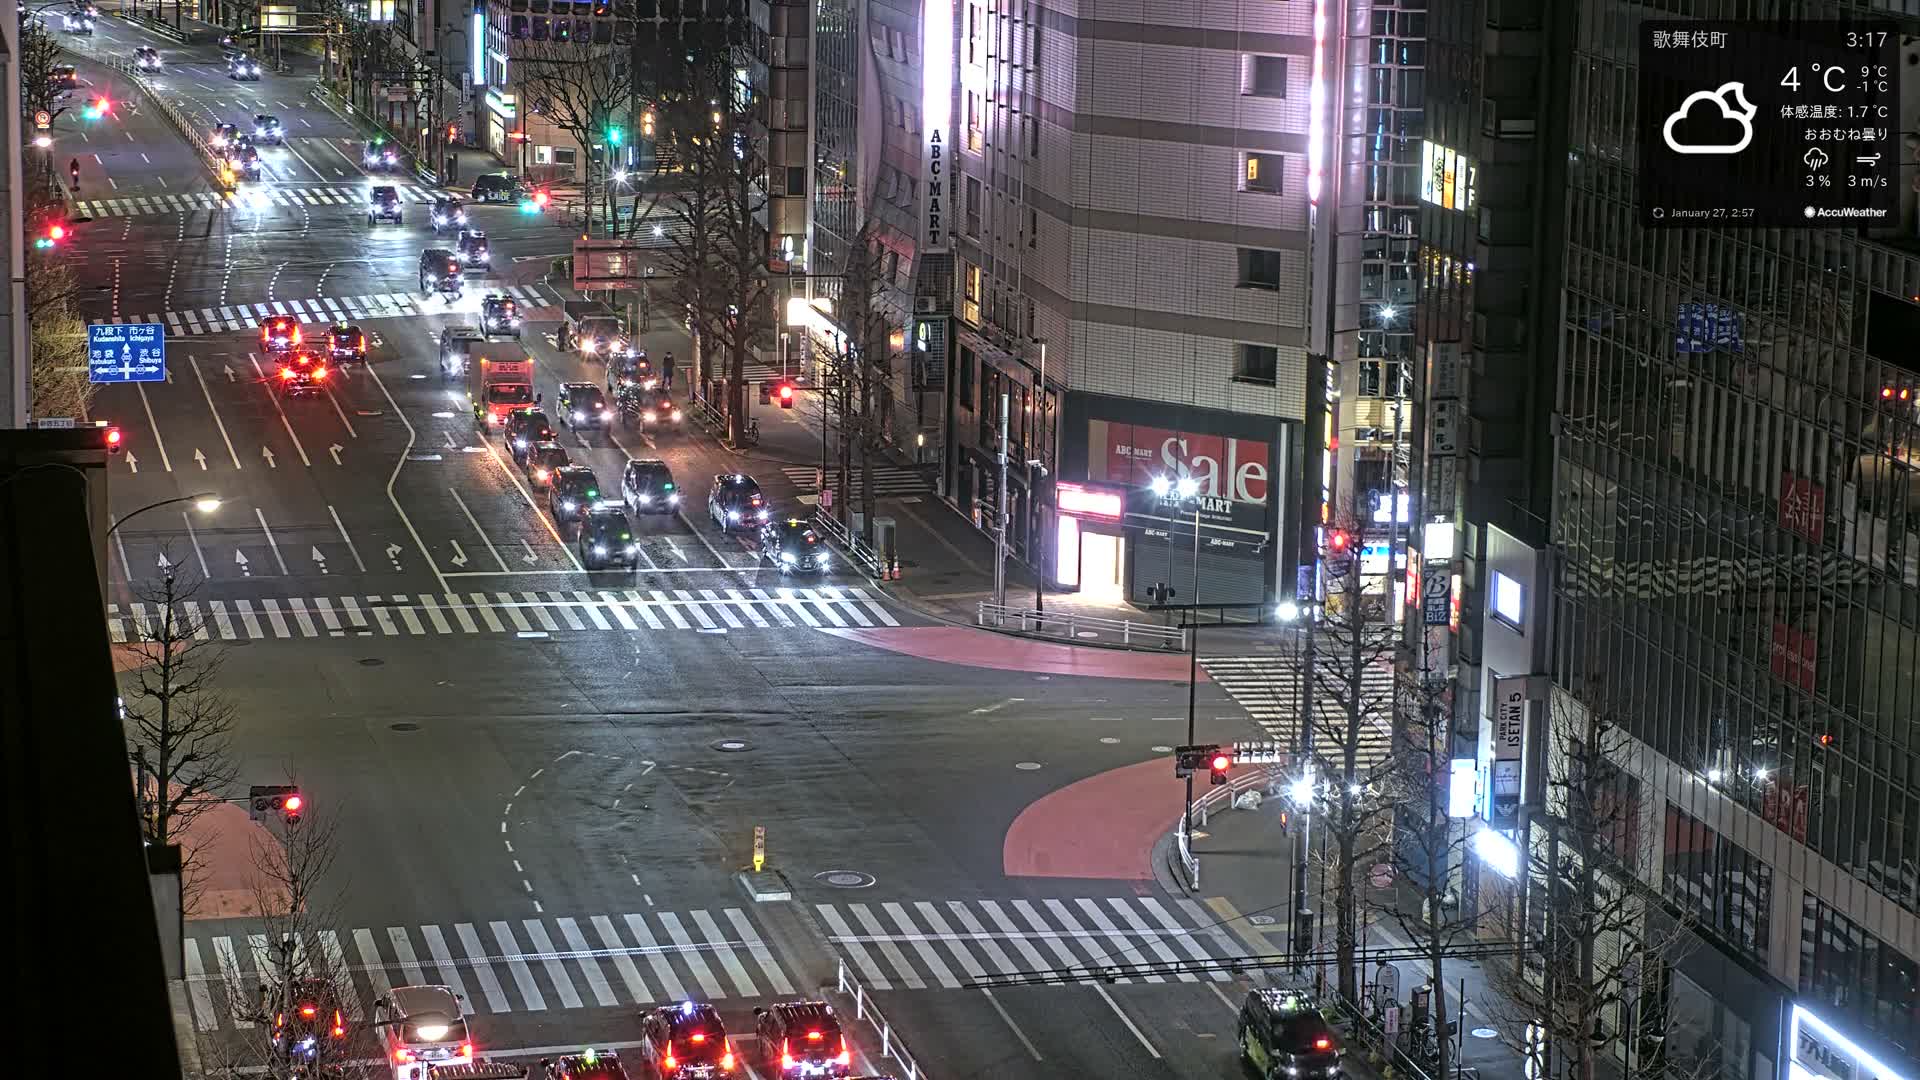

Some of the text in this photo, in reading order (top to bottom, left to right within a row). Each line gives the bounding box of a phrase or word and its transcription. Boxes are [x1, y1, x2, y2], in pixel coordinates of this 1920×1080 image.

[96, 326, 124, 335] 九段下
[139, 357, 162, 365] Shibuya
[1160, 437, 1267, 504] Sale
[1499, 703, 1508, 741] PARK CITY
[1507, 692, 1522, 747] ISETAN 5
